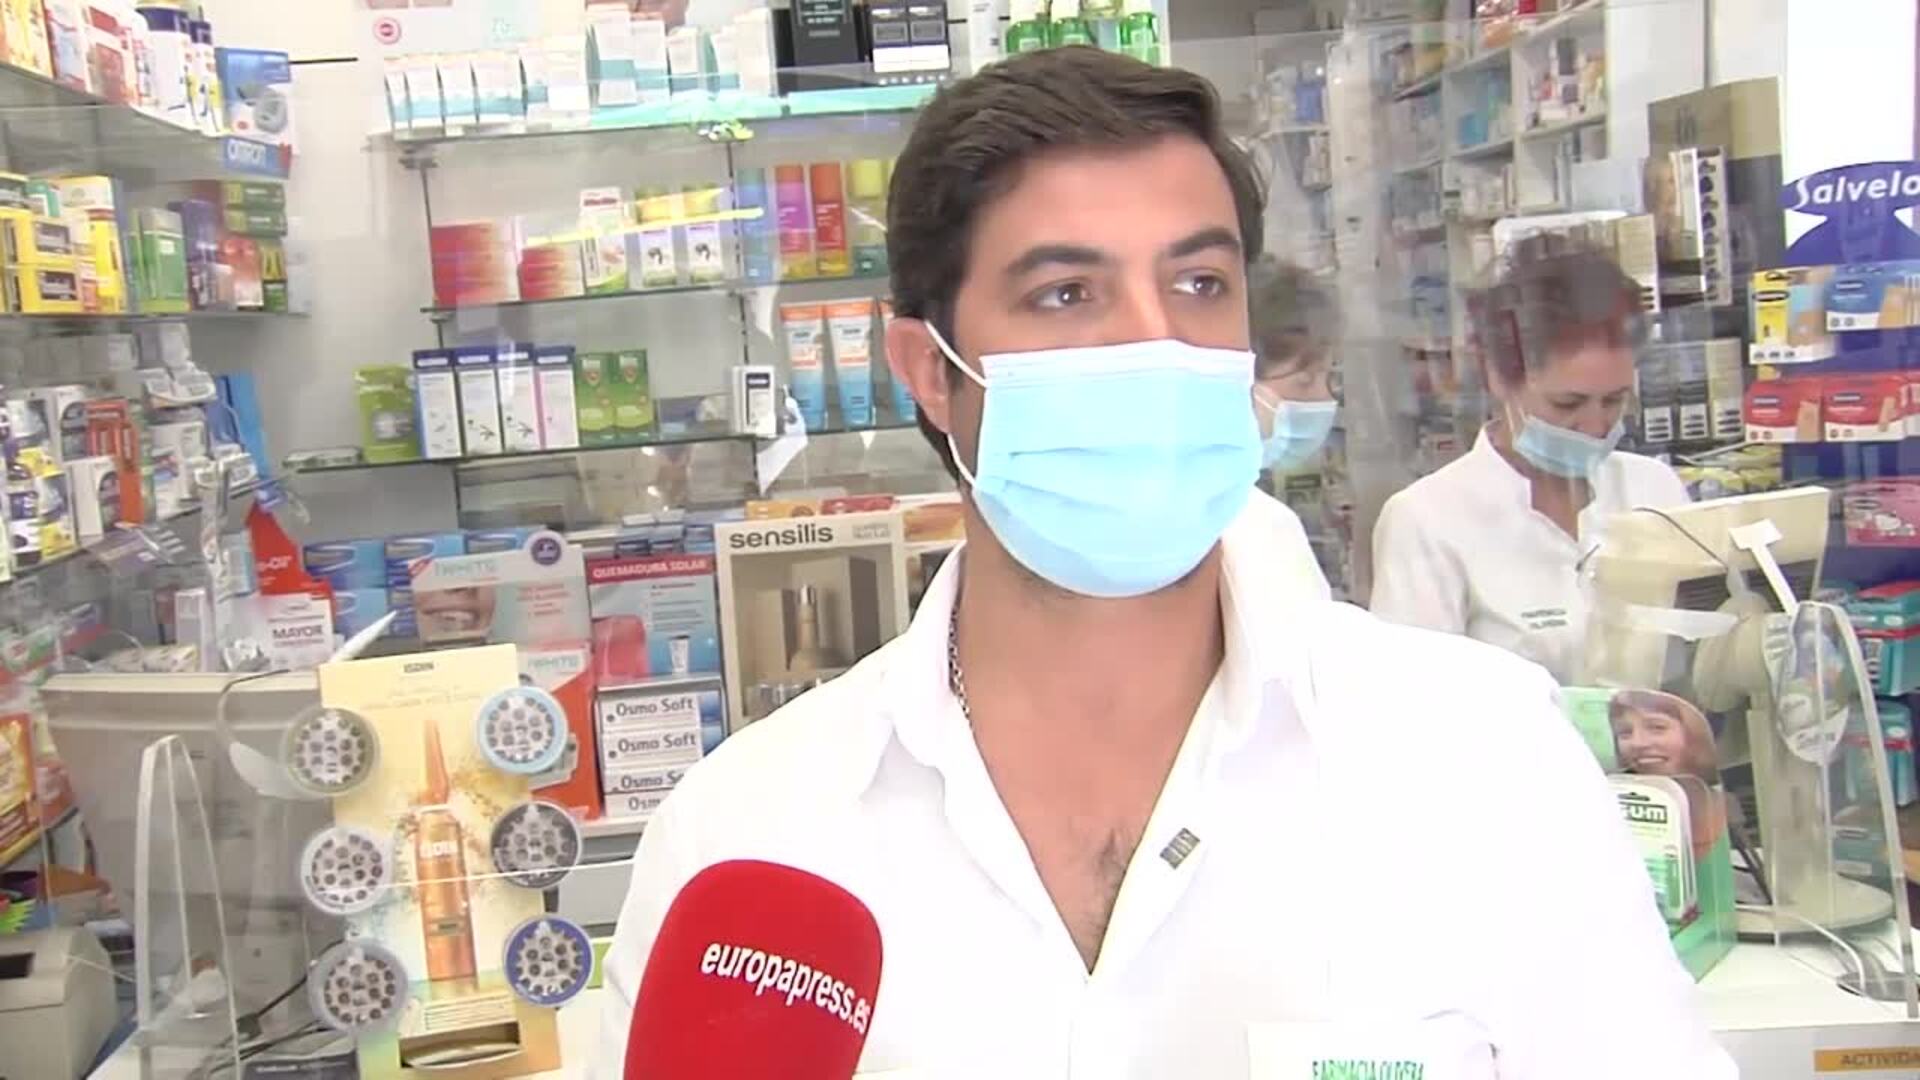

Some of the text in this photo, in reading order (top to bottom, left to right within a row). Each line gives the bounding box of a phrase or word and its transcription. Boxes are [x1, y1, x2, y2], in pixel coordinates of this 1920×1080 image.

[1792, 170, 1920, 210] Salvelo
[729, 523, 834, 549] sensilis
[592, 560, 707, 579] QUEMADURA SOLAR
[272, 624, 323, 640] MAYOR
[616, 697, 694, 717] Osmo Soft
[618, 732, 698, 753] Osmo Soft
[621, 775, 664, 789] Osmo
[701, 943, 872, 1035] europapress.es
